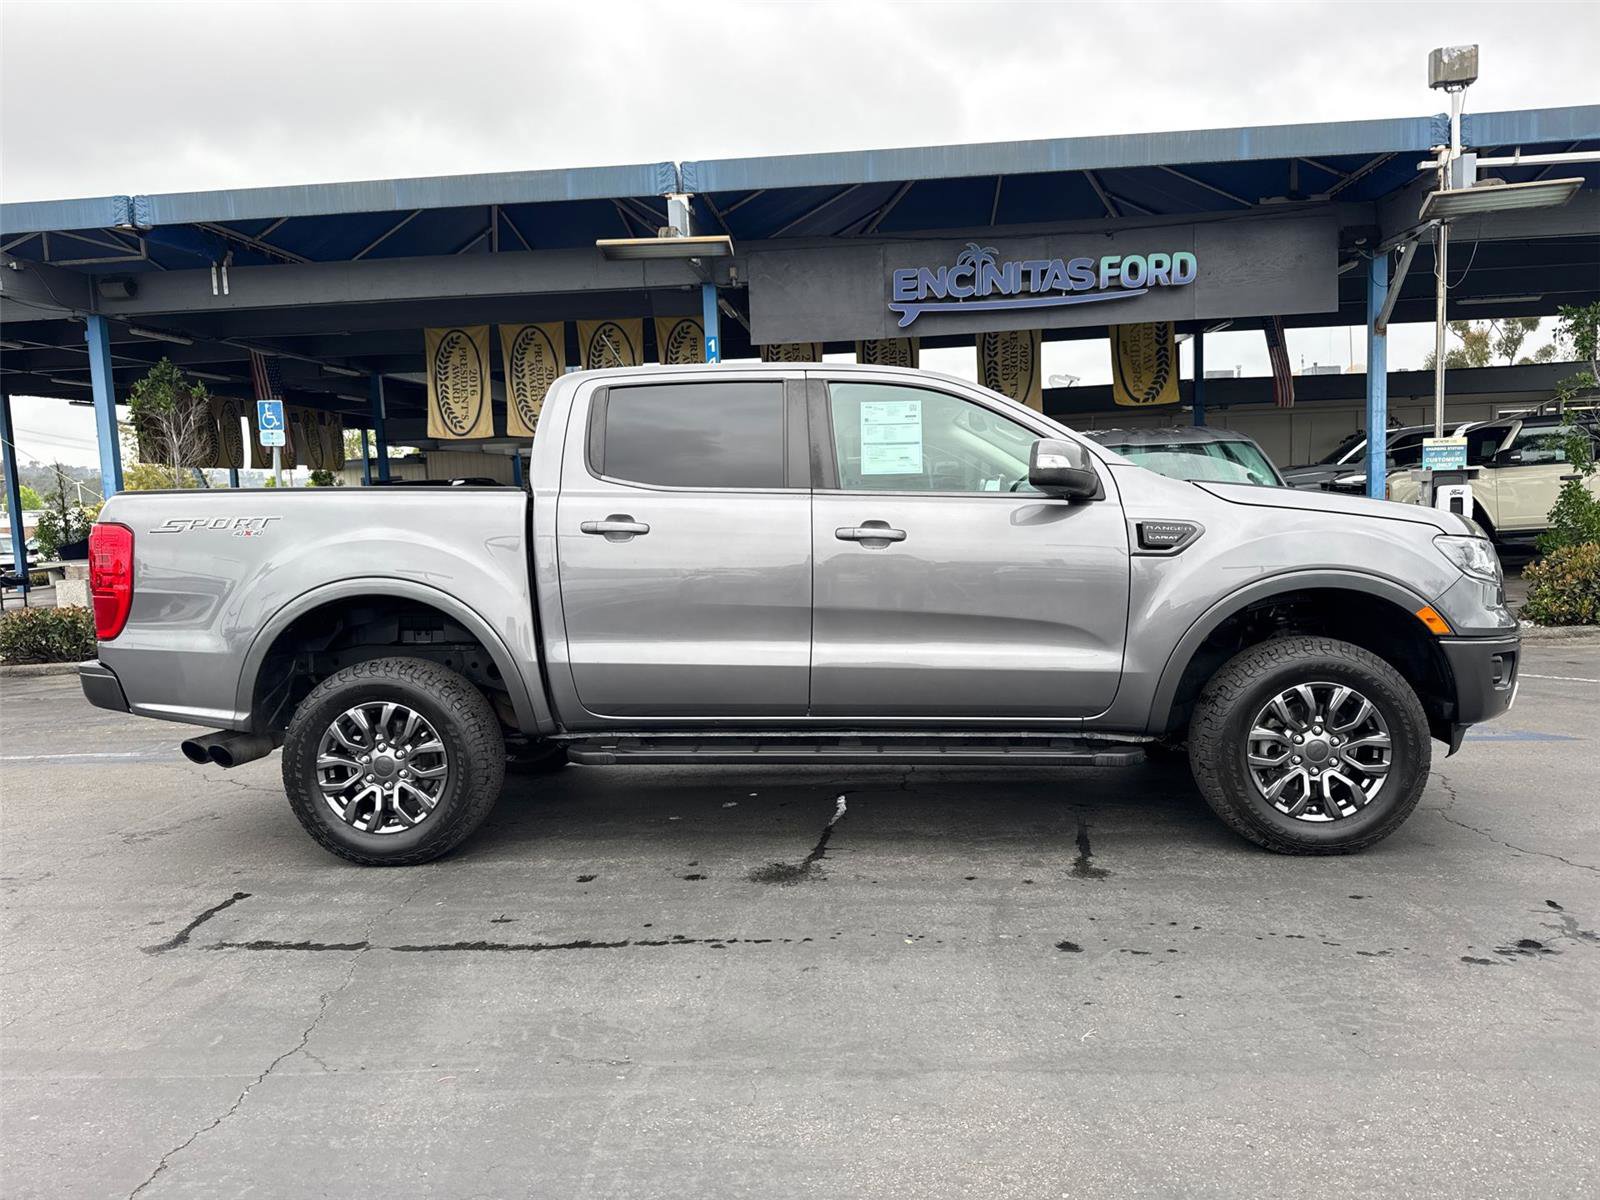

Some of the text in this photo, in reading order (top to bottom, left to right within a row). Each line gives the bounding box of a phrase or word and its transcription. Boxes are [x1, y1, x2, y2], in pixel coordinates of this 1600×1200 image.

[893, 251, 1197, 301] ENCINITAS FORD
[534, 343, 547, 406] PRESIDEN
[545, 366, 555, 386] 201
[1001, 338, 1010, 381] AWARD
[452, 364, 461, 404] AWARD
[459, 346, 470, 421] PRESIDENT'S
[469, 369, 478, 397] 2016
[527, 360, 539, 402] AWARD
[148, 517, 282, 534] SPORT
